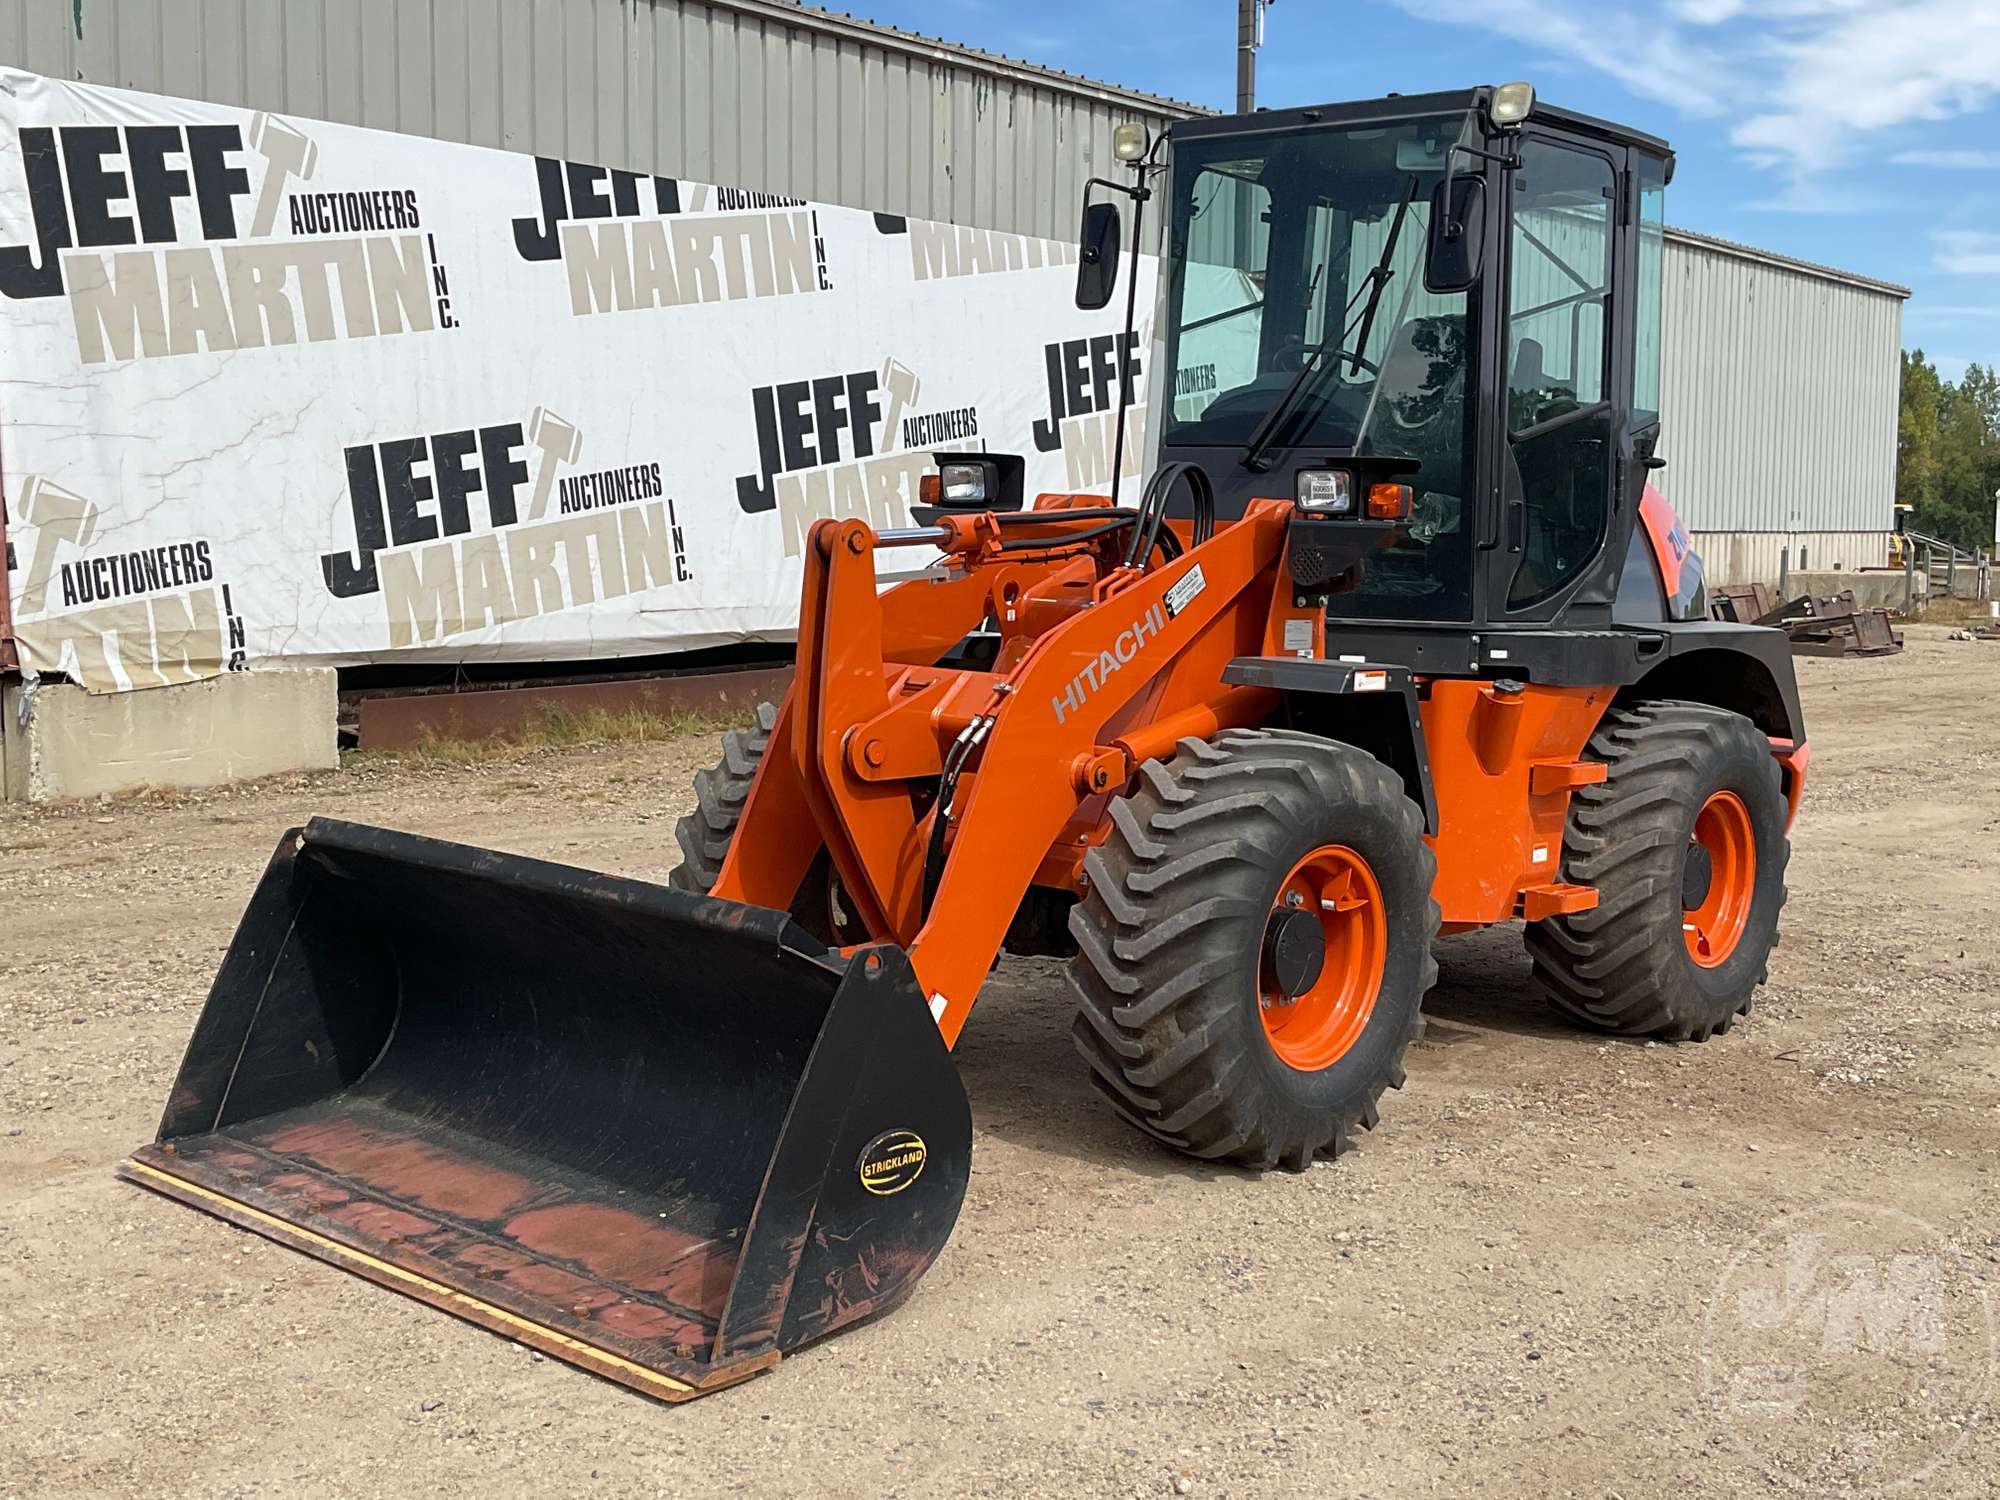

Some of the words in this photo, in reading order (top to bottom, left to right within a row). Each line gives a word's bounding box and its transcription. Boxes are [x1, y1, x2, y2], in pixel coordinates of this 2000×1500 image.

[0, 125, 250, 299] JEFF
[289, 190, 420, 235] AUCTIONEERS
[812, 210, 833, 291] INC.
[64, 235, 434, 364] MARTIN
[428, 233, 459, 328] INC.
[562, 212, 815, 316] MARTIN
[903, 407, 977, 448] AUCTIONEERS
[1032, 331, 1142, 452] JEFF
[559, 462, 663, 515] AUCTIONEERS
[736, 370, 882, 514] JEFF
[321, 422, 529, 598] JEFF
[668, 499, 693, 582] INC.
[61, 540, 213, 607] AUCTIONEERS
[379, 501, 672, 648] MARTIN
[1052, 603, 1165, 724] HITACHI
[864, 1150, 922, 1176] STRICKLAND
